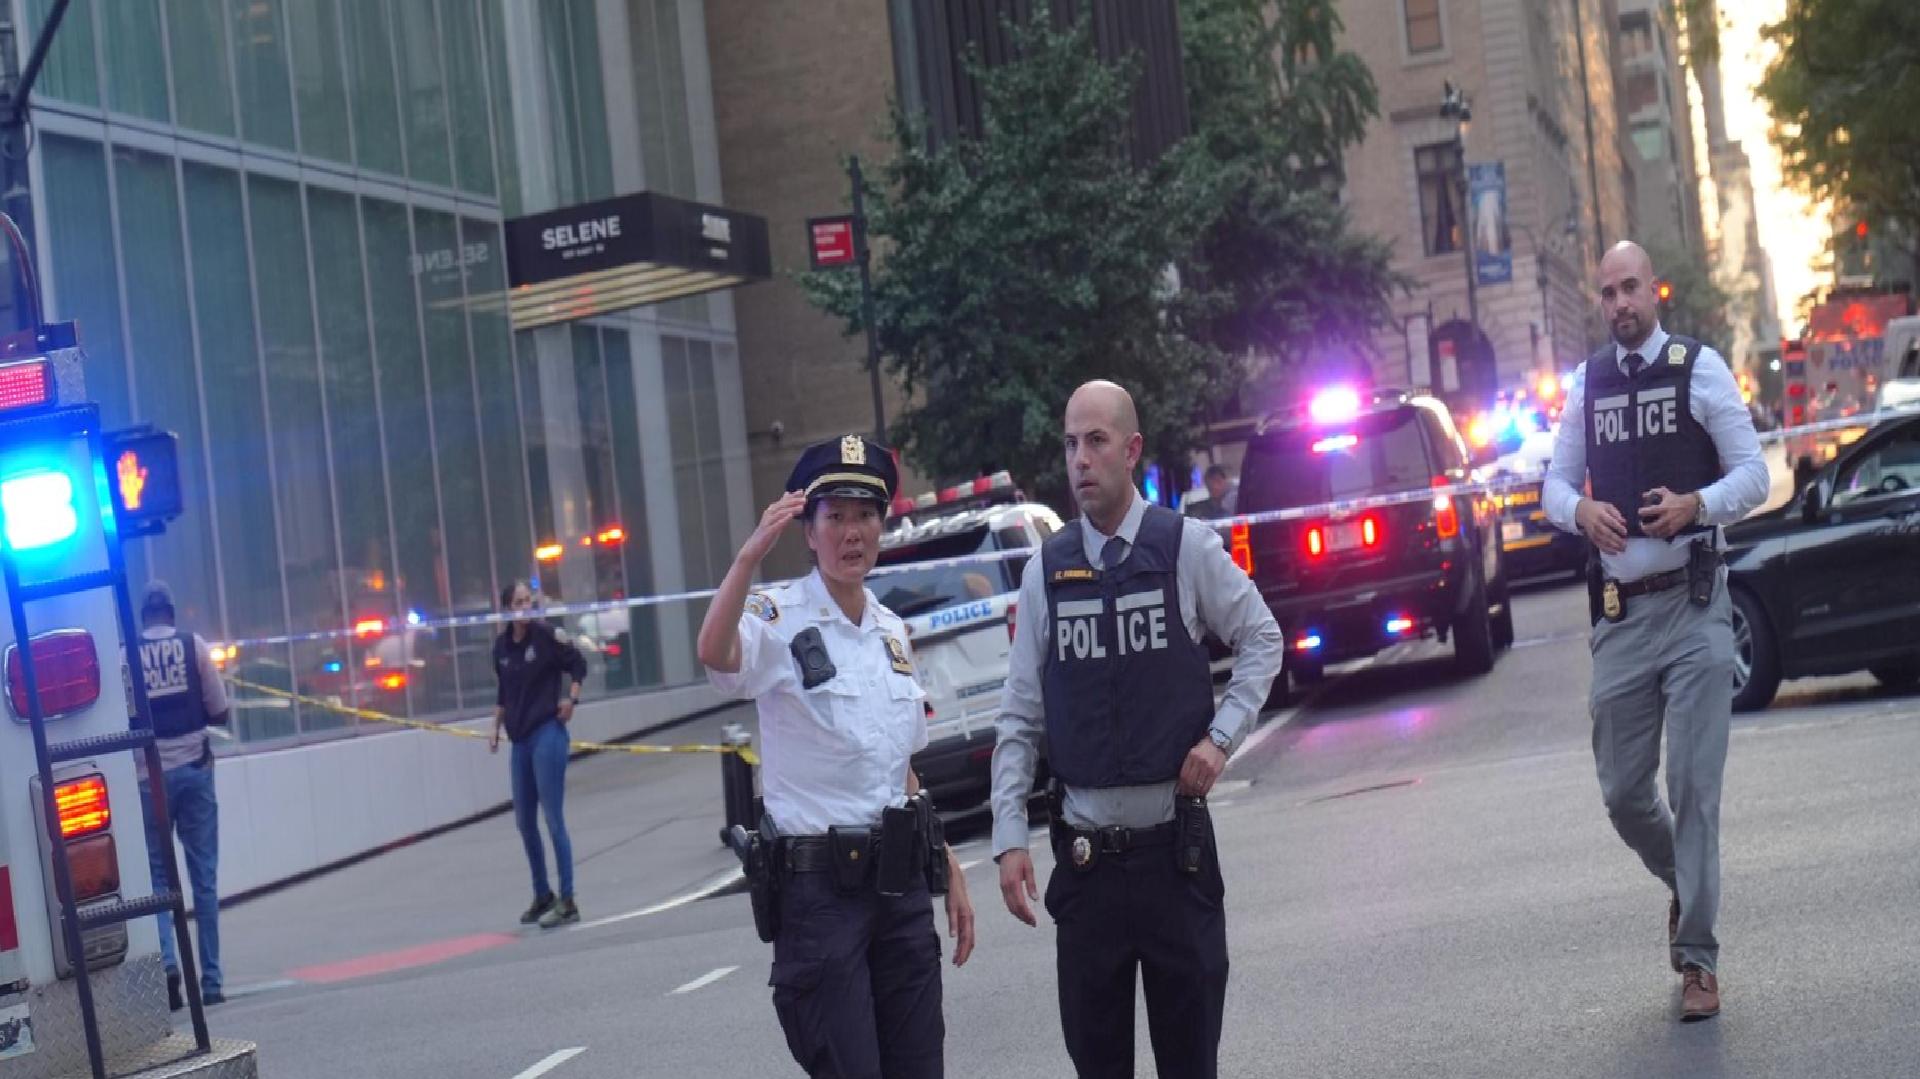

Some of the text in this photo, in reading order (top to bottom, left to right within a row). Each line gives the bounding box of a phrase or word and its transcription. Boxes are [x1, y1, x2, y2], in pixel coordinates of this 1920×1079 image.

[541, 215, 622, 250] SELENE
[1593, 399, 1678, 446] POLICE
[929, 601, 993, 629] POLICE
[1057, 607, 1168, 662] POLICE
[139, 639, 185, 669] NYPD
